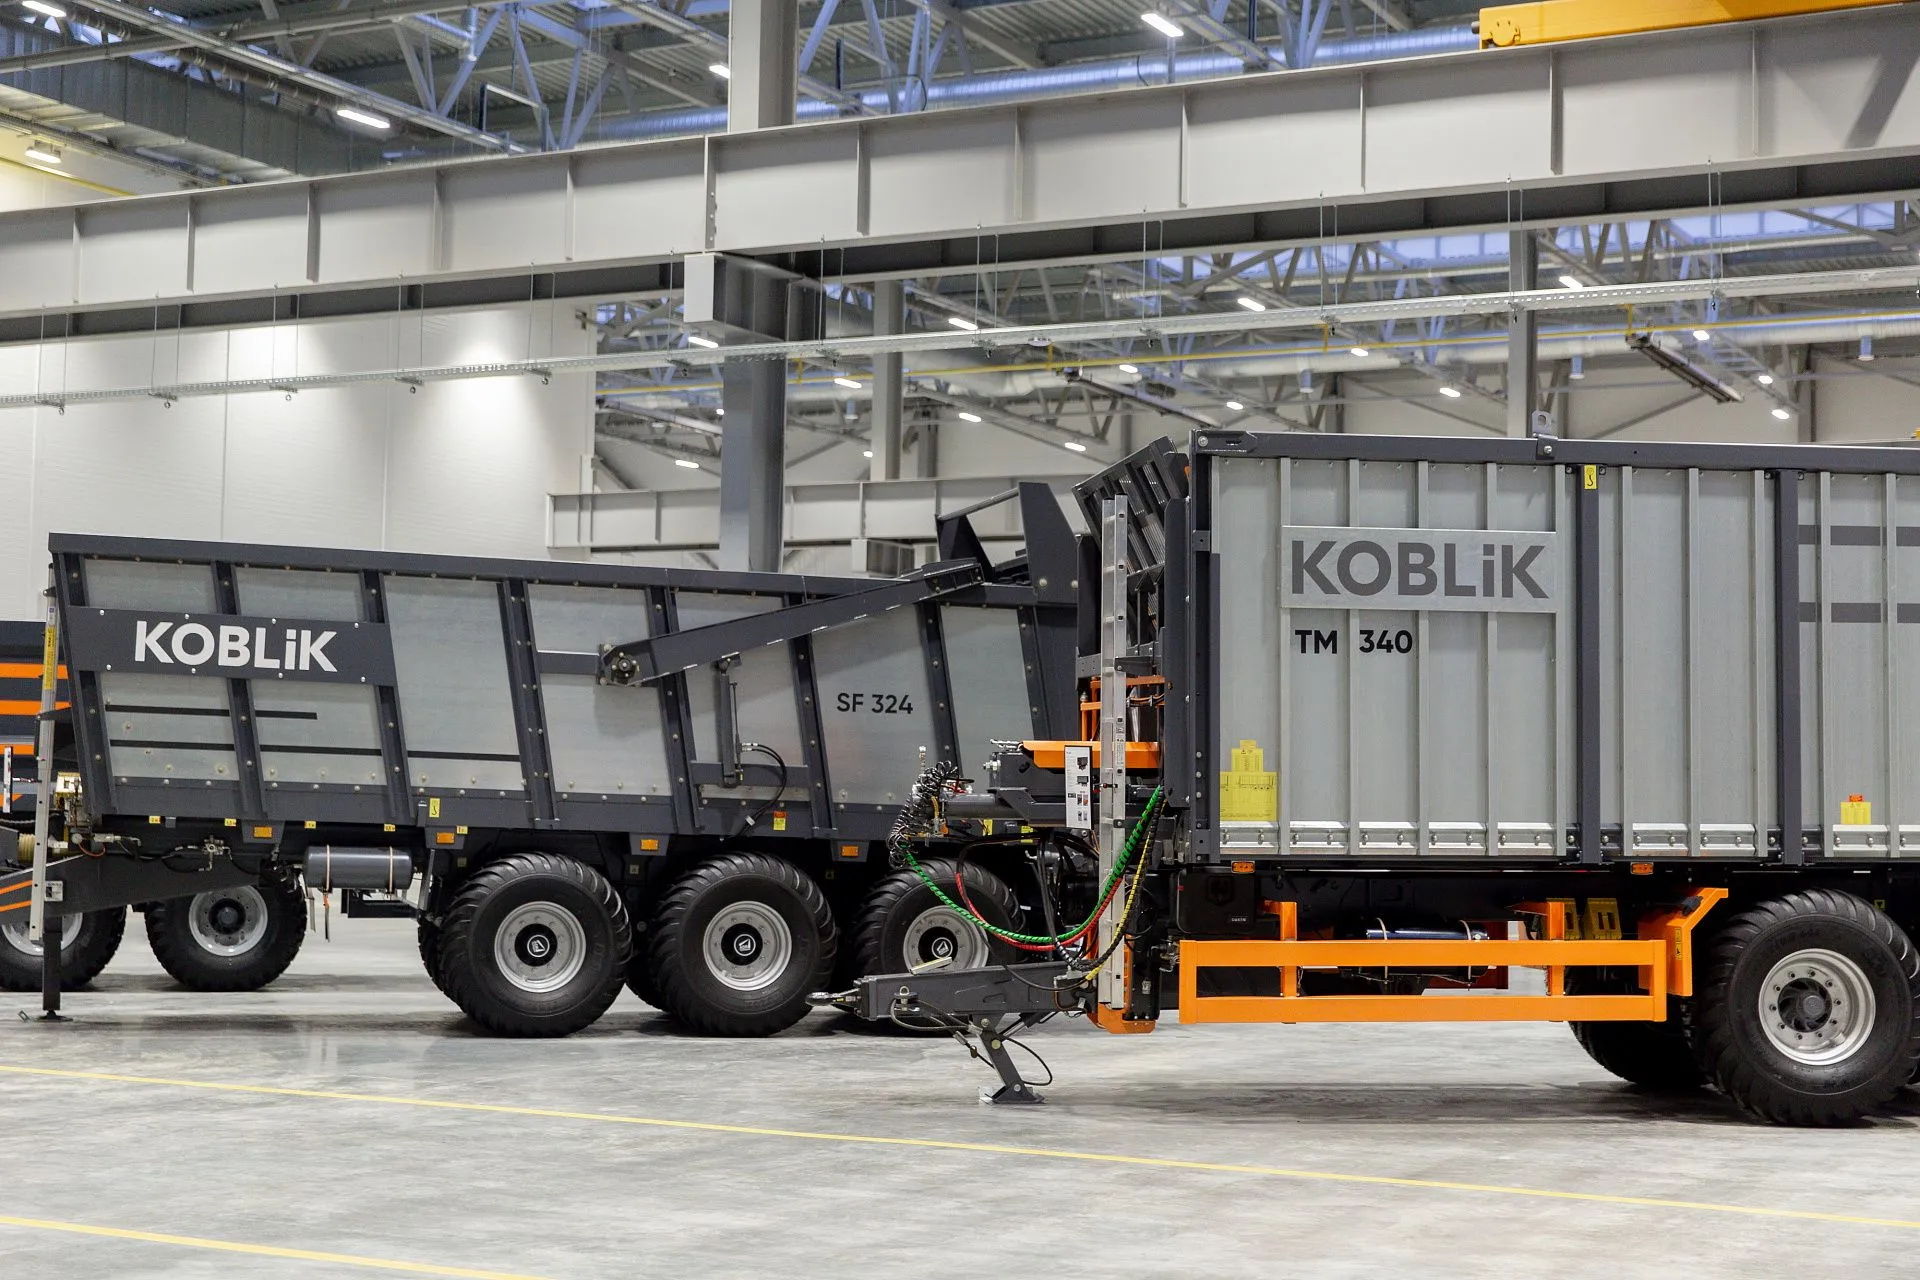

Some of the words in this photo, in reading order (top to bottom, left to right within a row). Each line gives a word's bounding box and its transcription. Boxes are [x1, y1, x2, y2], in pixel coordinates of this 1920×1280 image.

[1291, 540, 1549, 599] KOBLiK
[135, 620, 338, 673] KOBLiK
[1295, 629, 1338, 654] TM
[1359, 629, 1413, 654] 340
[836, 692, 865, 713] SF
[871, 694, 914, 715] 324
